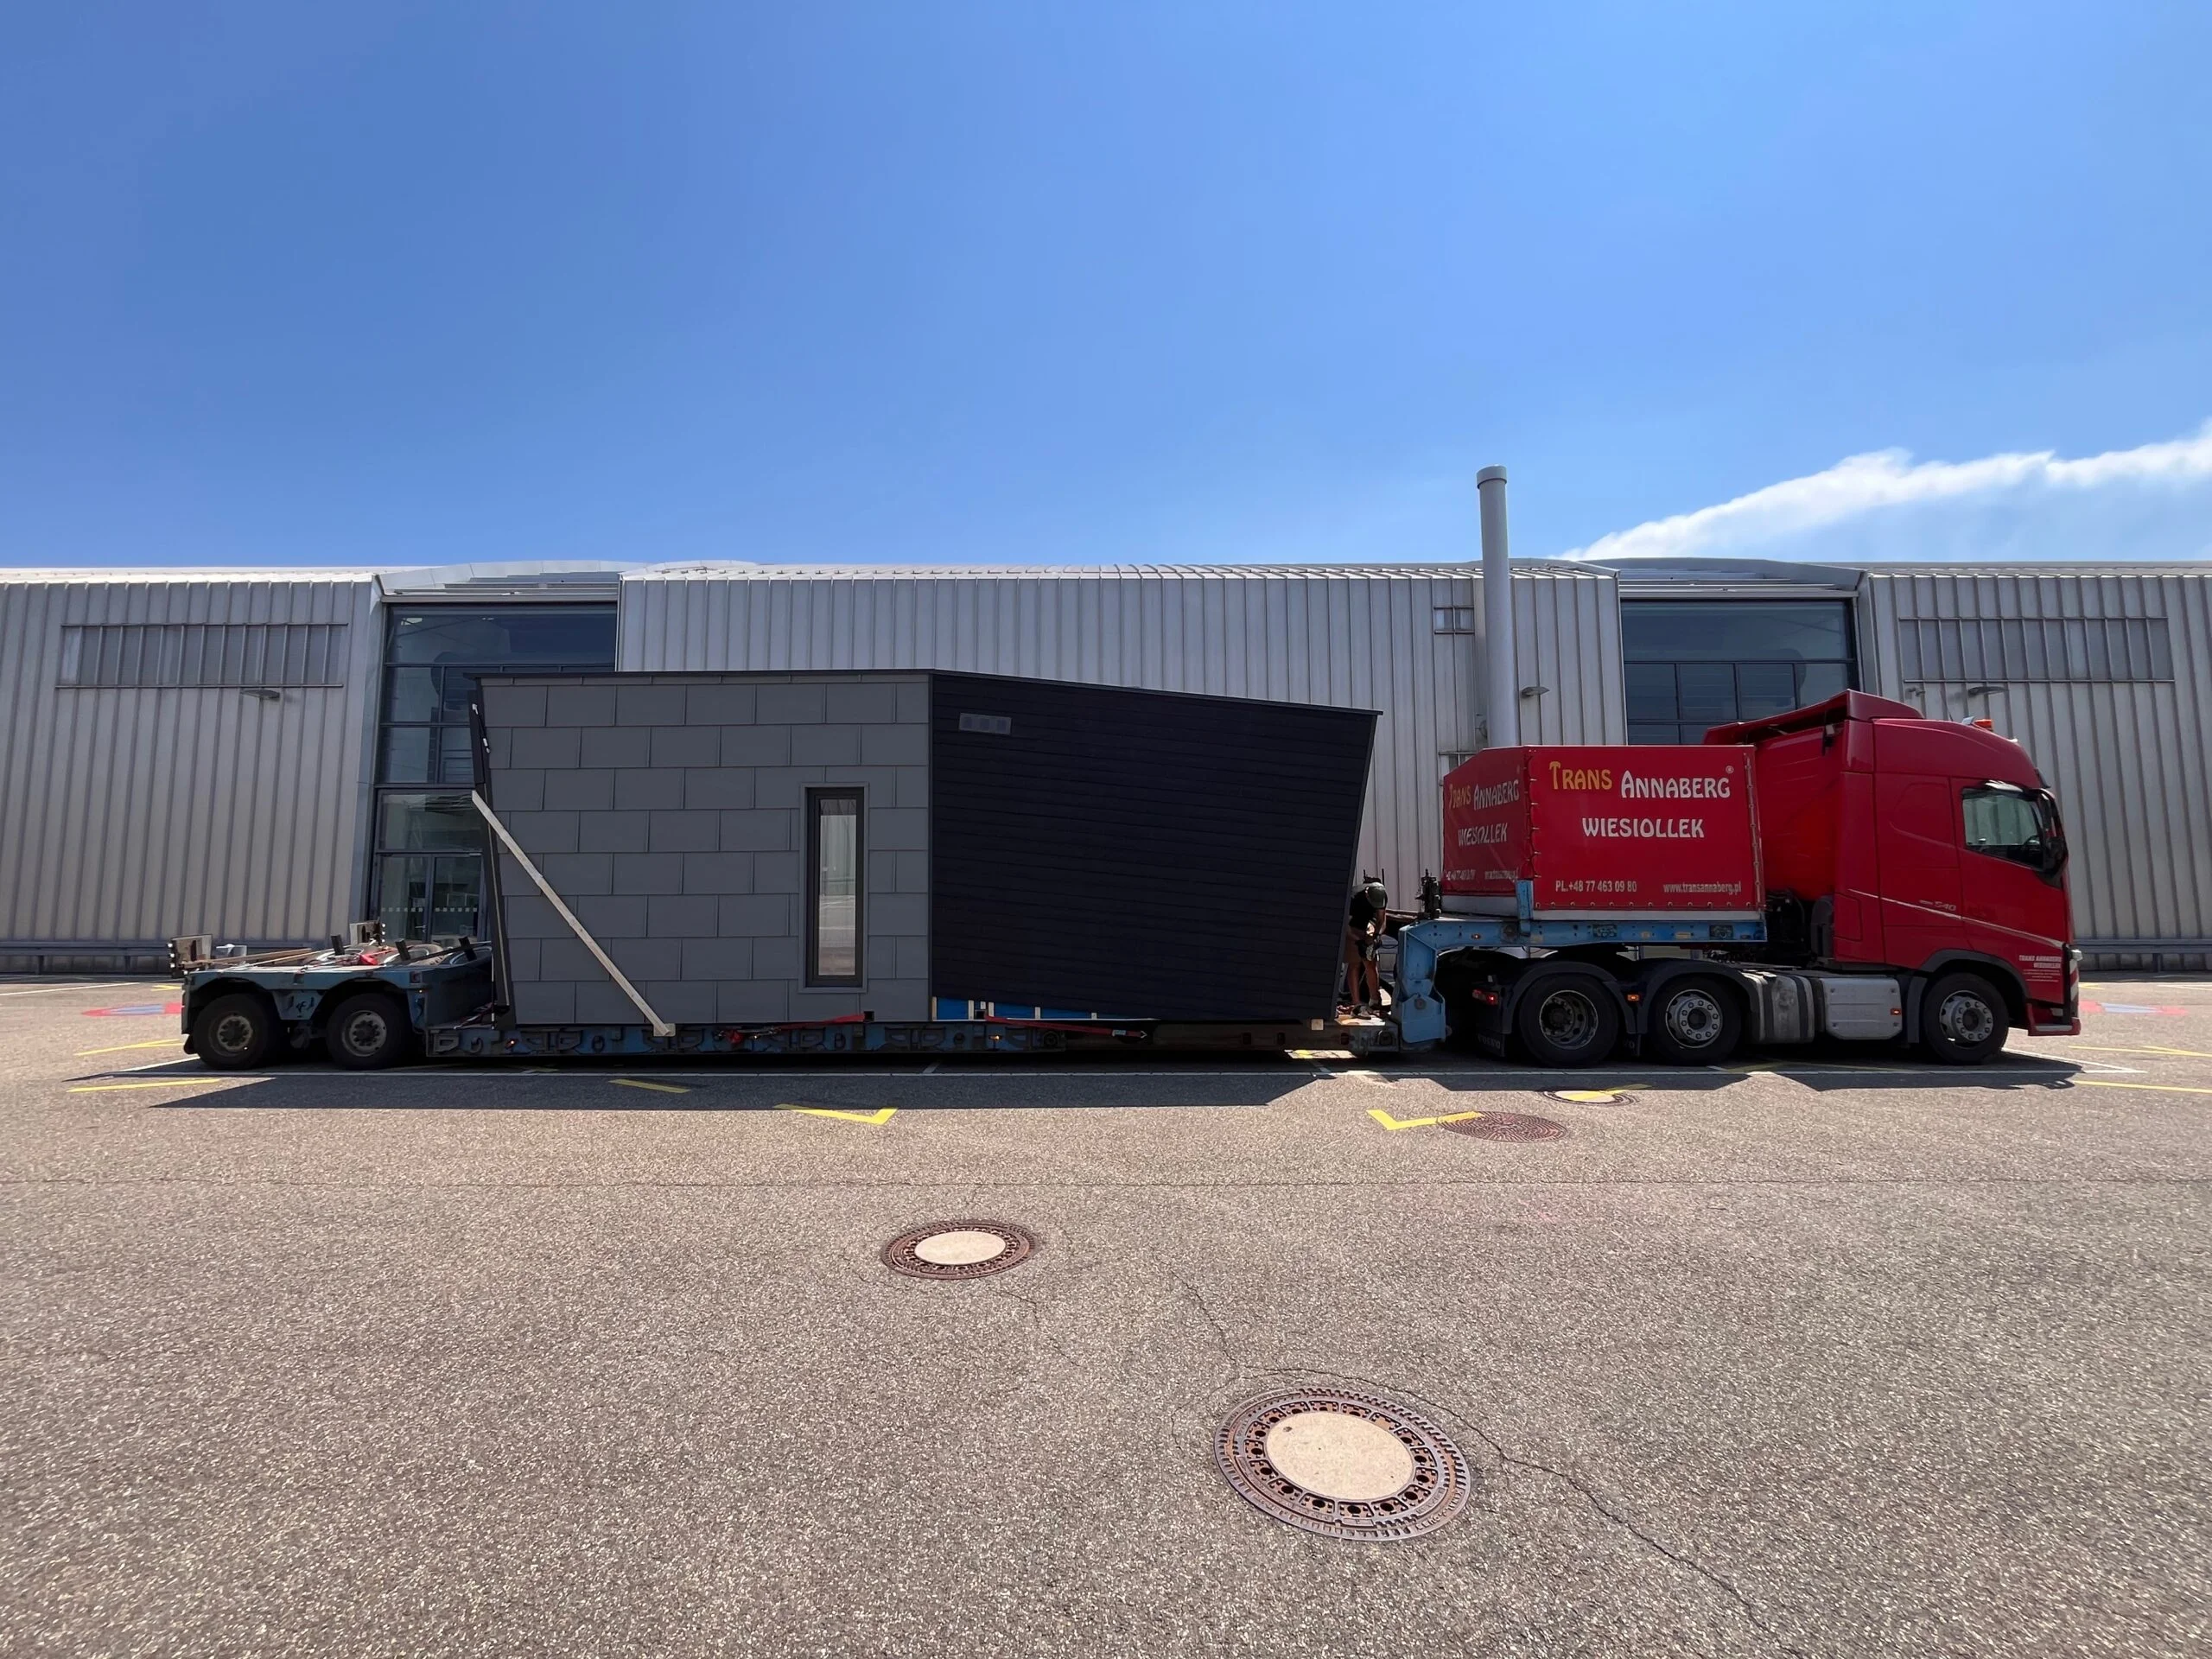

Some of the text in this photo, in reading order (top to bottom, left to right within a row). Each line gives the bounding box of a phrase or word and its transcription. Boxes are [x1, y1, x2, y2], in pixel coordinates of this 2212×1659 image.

[1549, 761, 1612, 790] TRANS
[1473, 779, 1520, 810] ANNABERG
[1582, 817, 1705, 838] WIESIOLLEK
[1586, 880, 1595, 893] 77
[1597, 880, 1612, 893] 463
